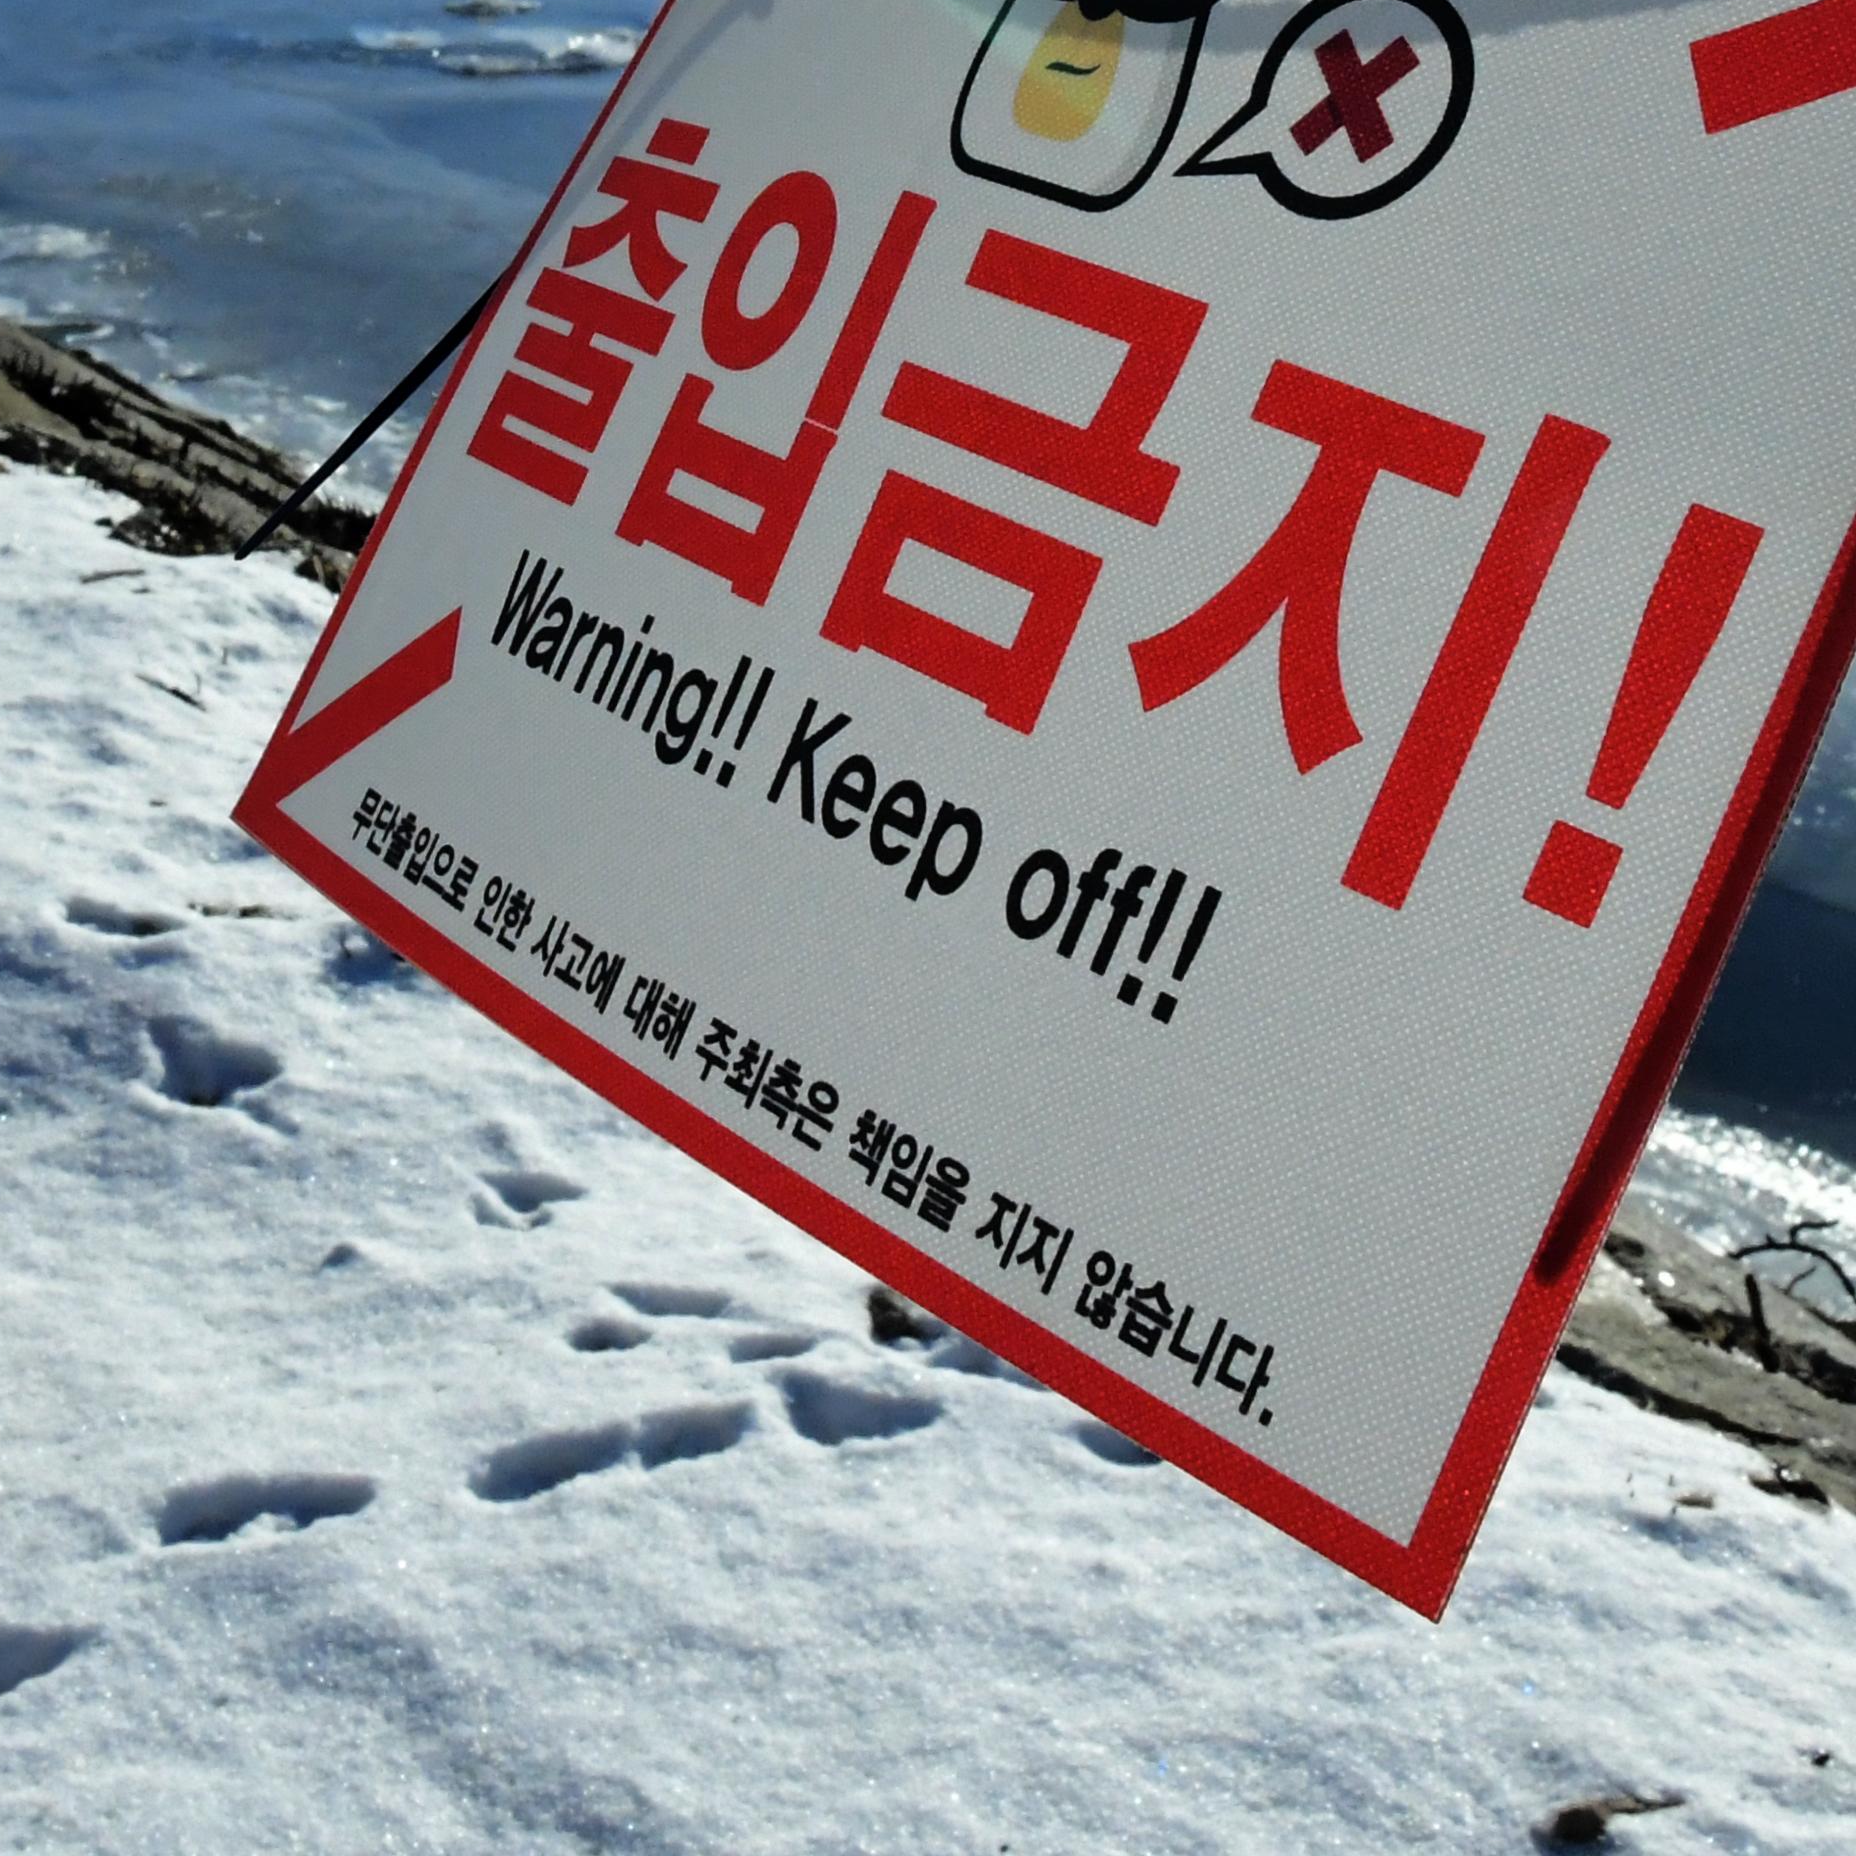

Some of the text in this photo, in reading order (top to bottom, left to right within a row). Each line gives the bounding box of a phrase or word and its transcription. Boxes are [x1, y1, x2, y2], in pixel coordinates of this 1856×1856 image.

[466, 119, 1765, 929] 출입금지!
[489, 548, 1223, 1025] Warning!! Keep off!!
[351, 787, 1275, 1427] 무단출입으로 인한 사고에 대해 주최측은 책임을 지지 않습니다.
